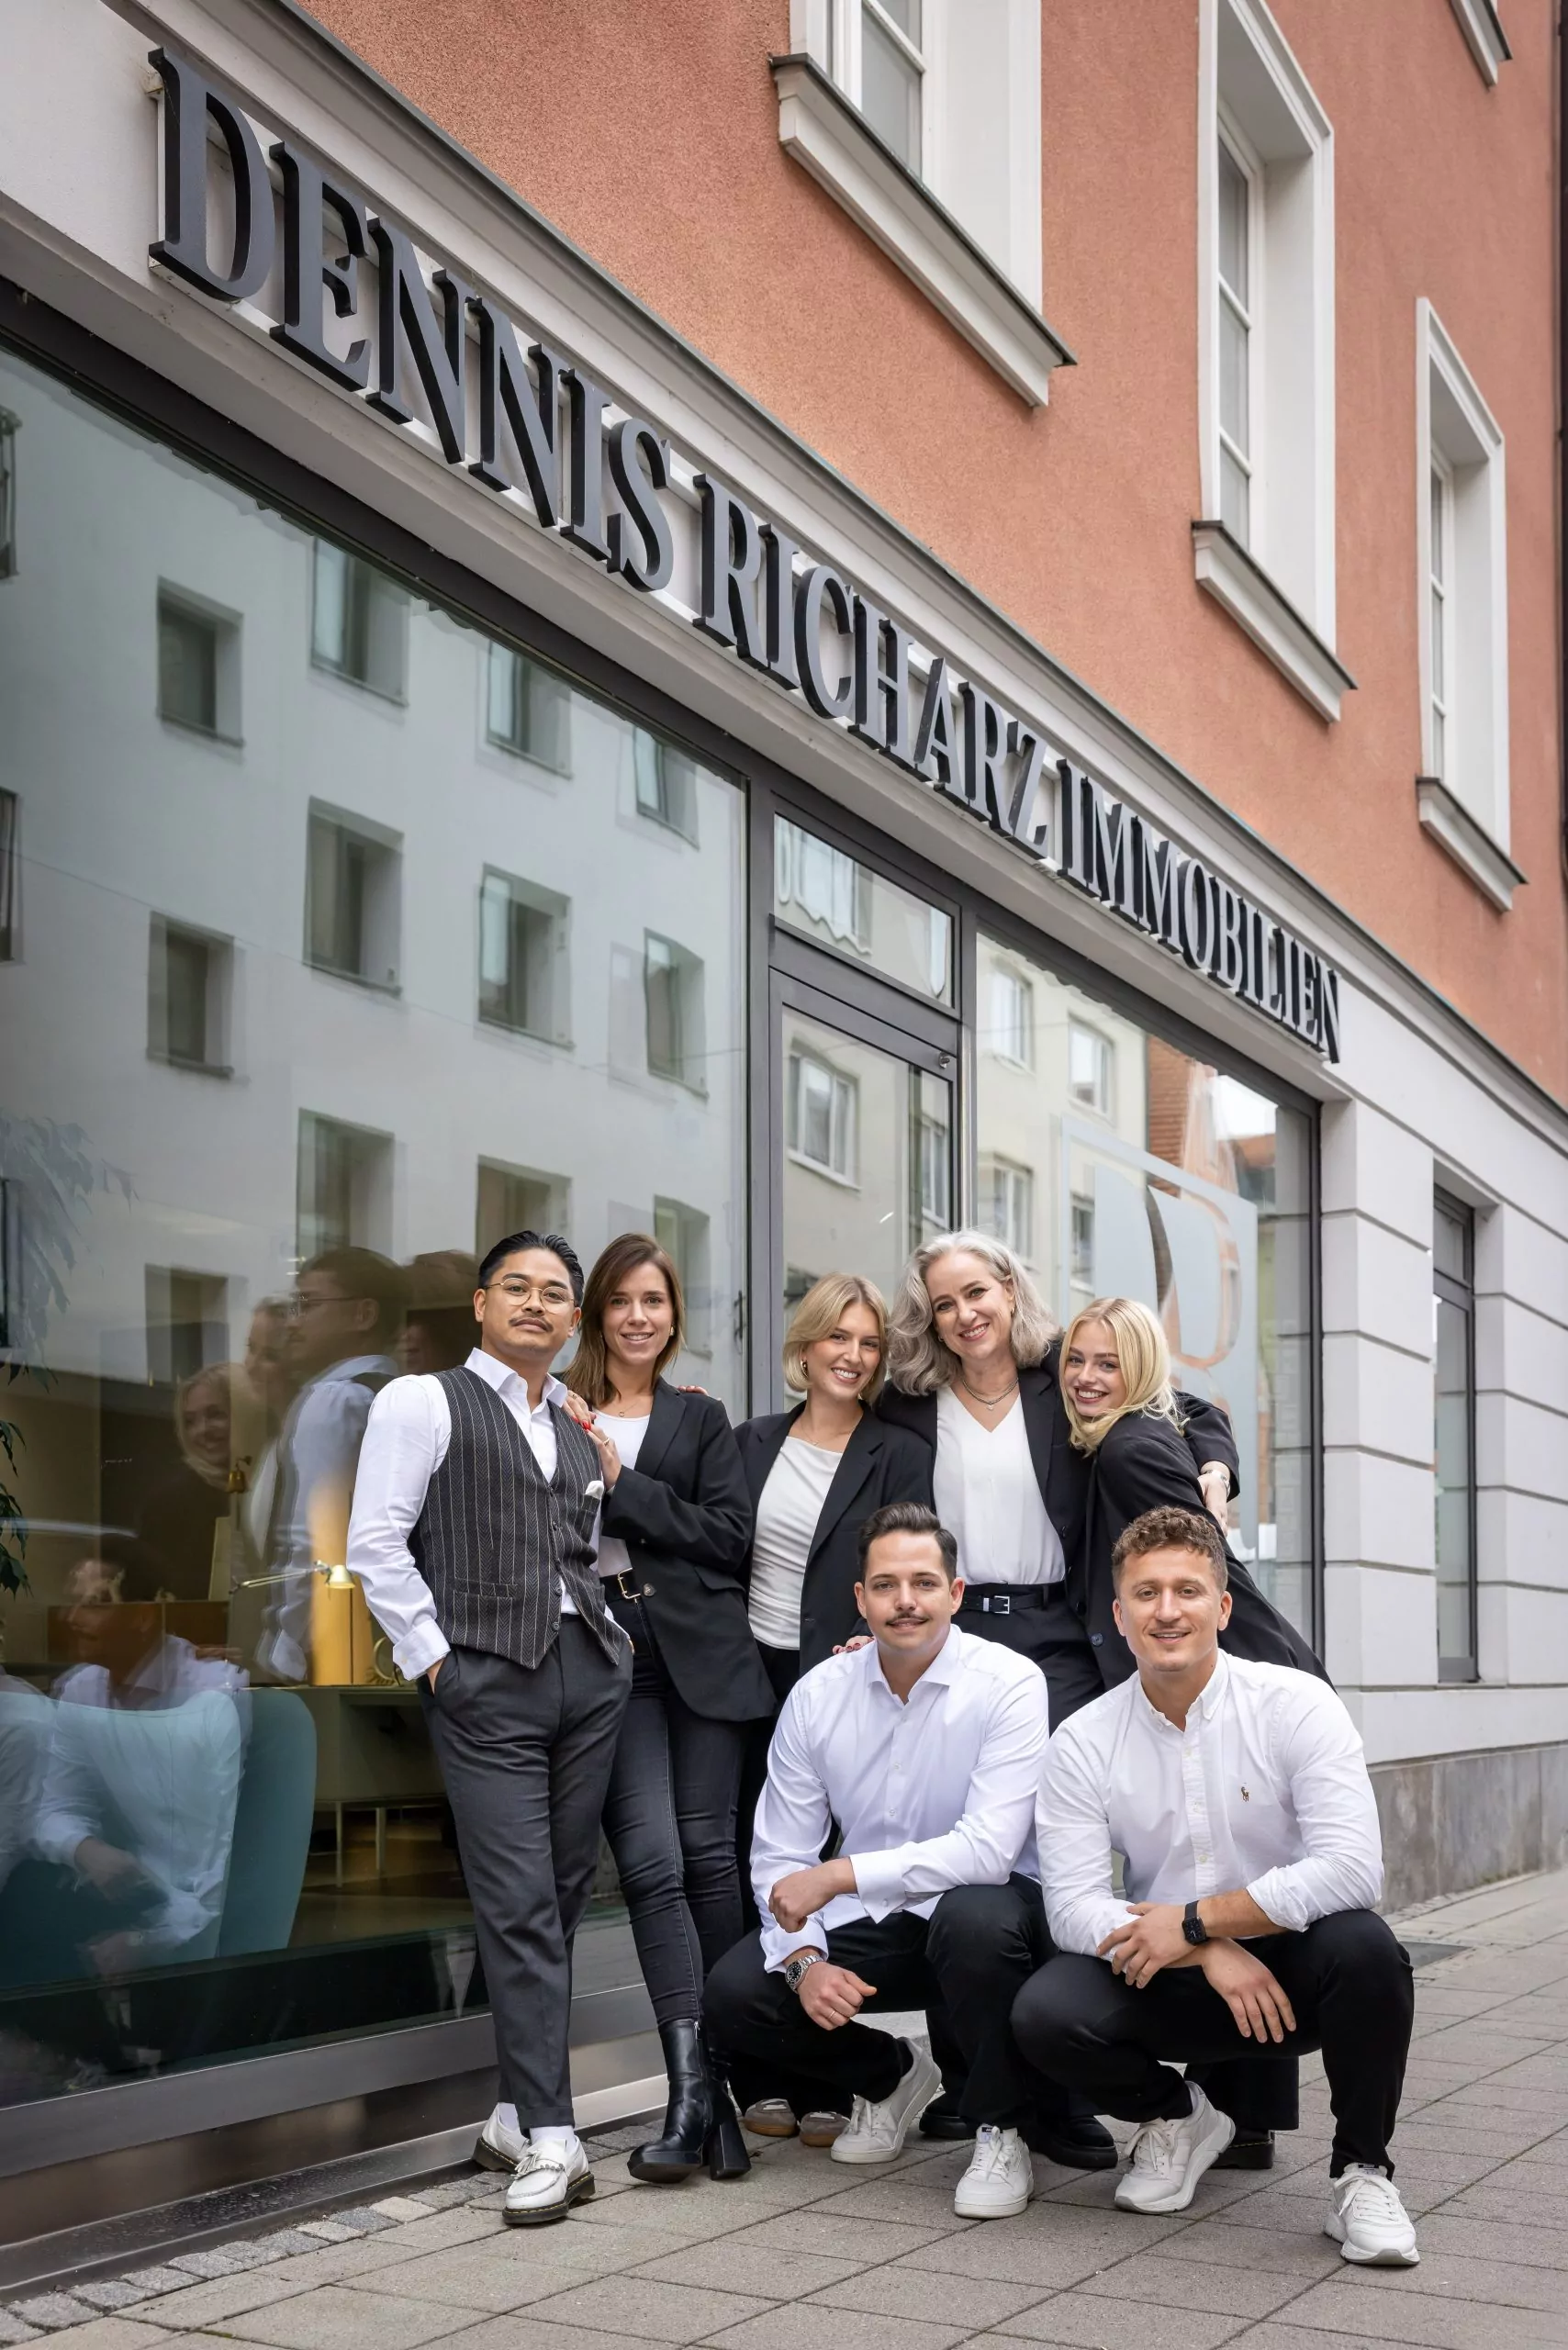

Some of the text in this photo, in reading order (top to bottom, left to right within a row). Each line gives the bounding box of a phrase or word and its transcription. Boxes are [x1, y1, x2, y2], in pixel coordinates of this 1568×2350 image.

[148, 48, 1340, 1063] DENNIS RICHARZ IMMOBILIEN
